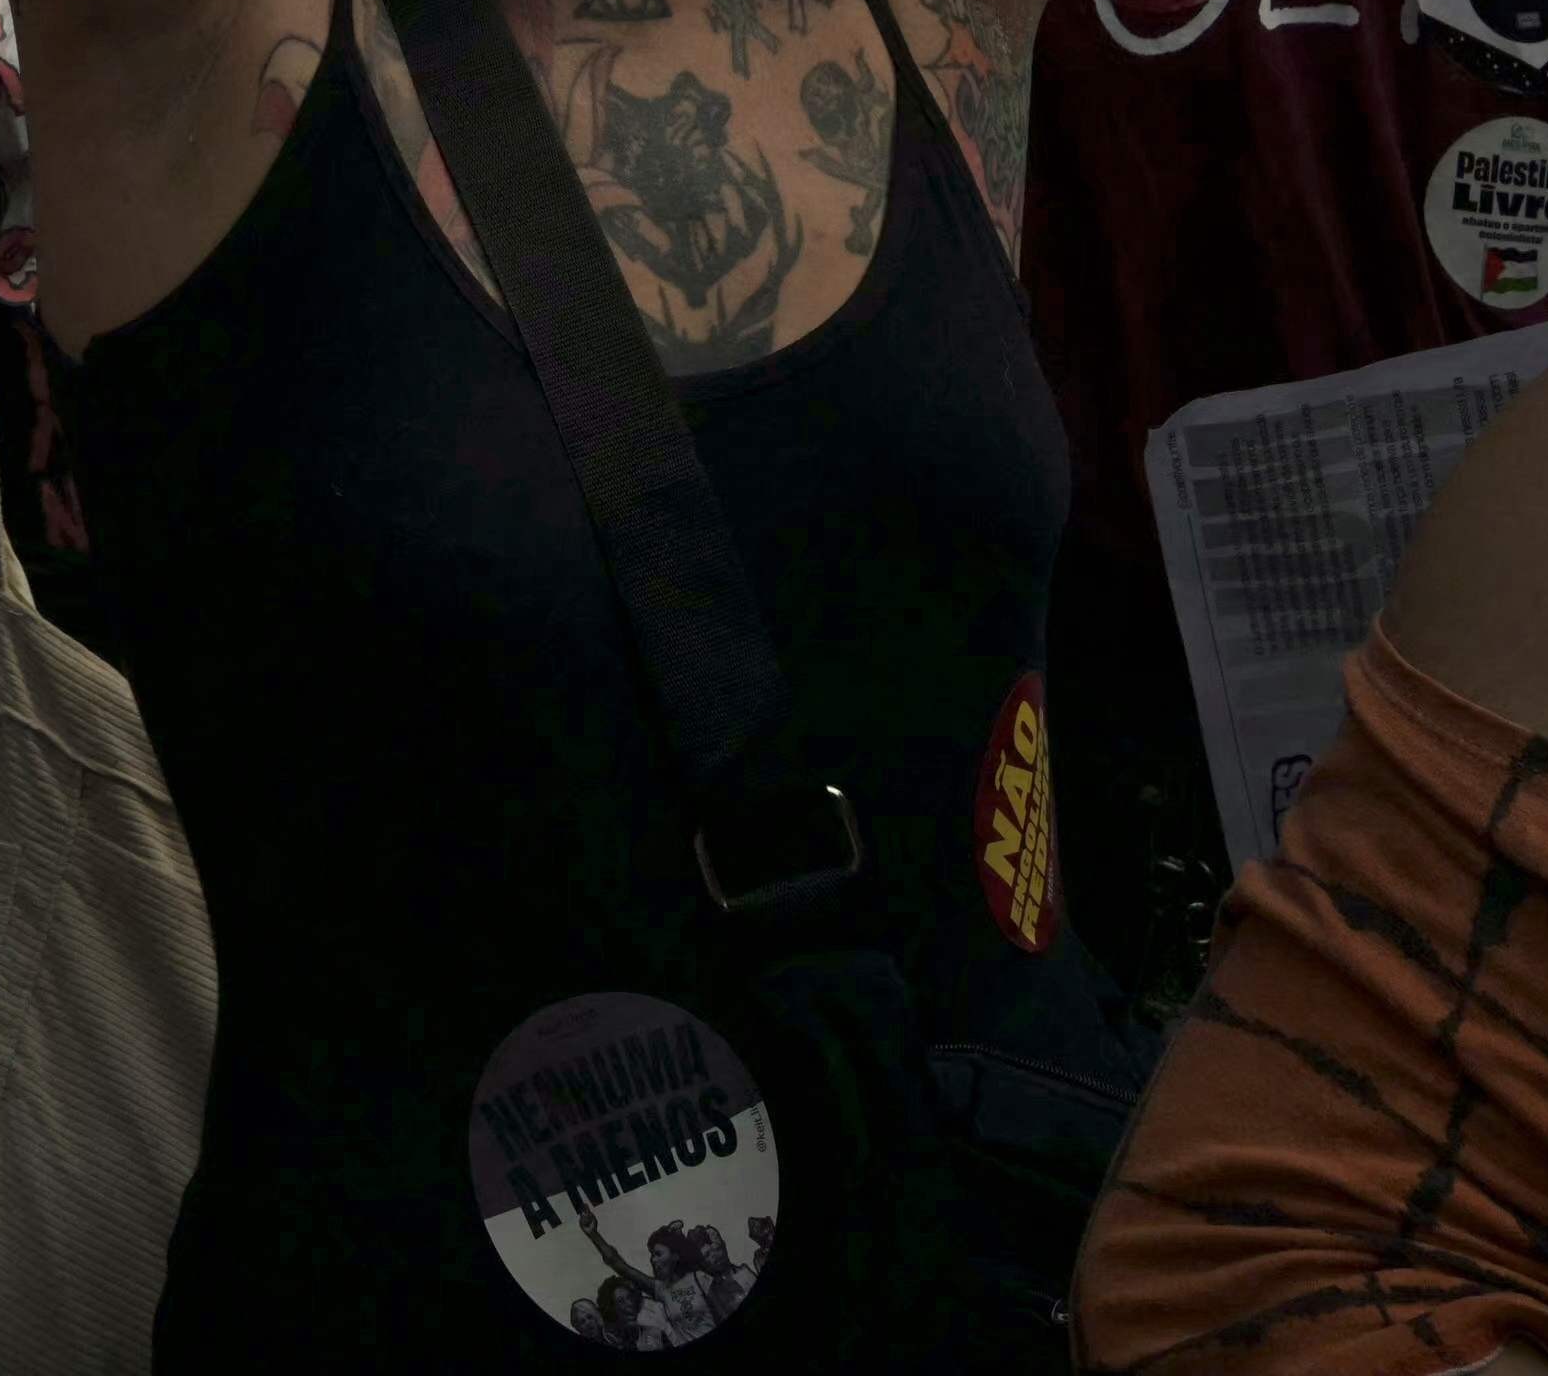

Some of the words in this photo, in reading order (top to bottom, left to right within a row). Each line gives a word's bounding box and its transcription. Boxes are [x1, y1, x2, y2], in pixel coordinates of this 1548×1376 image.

[984, 699, 1039, 888] NÃO
[508, 1167, 562, 1240] A
[549, 1088, 738, 1216] MENOS
